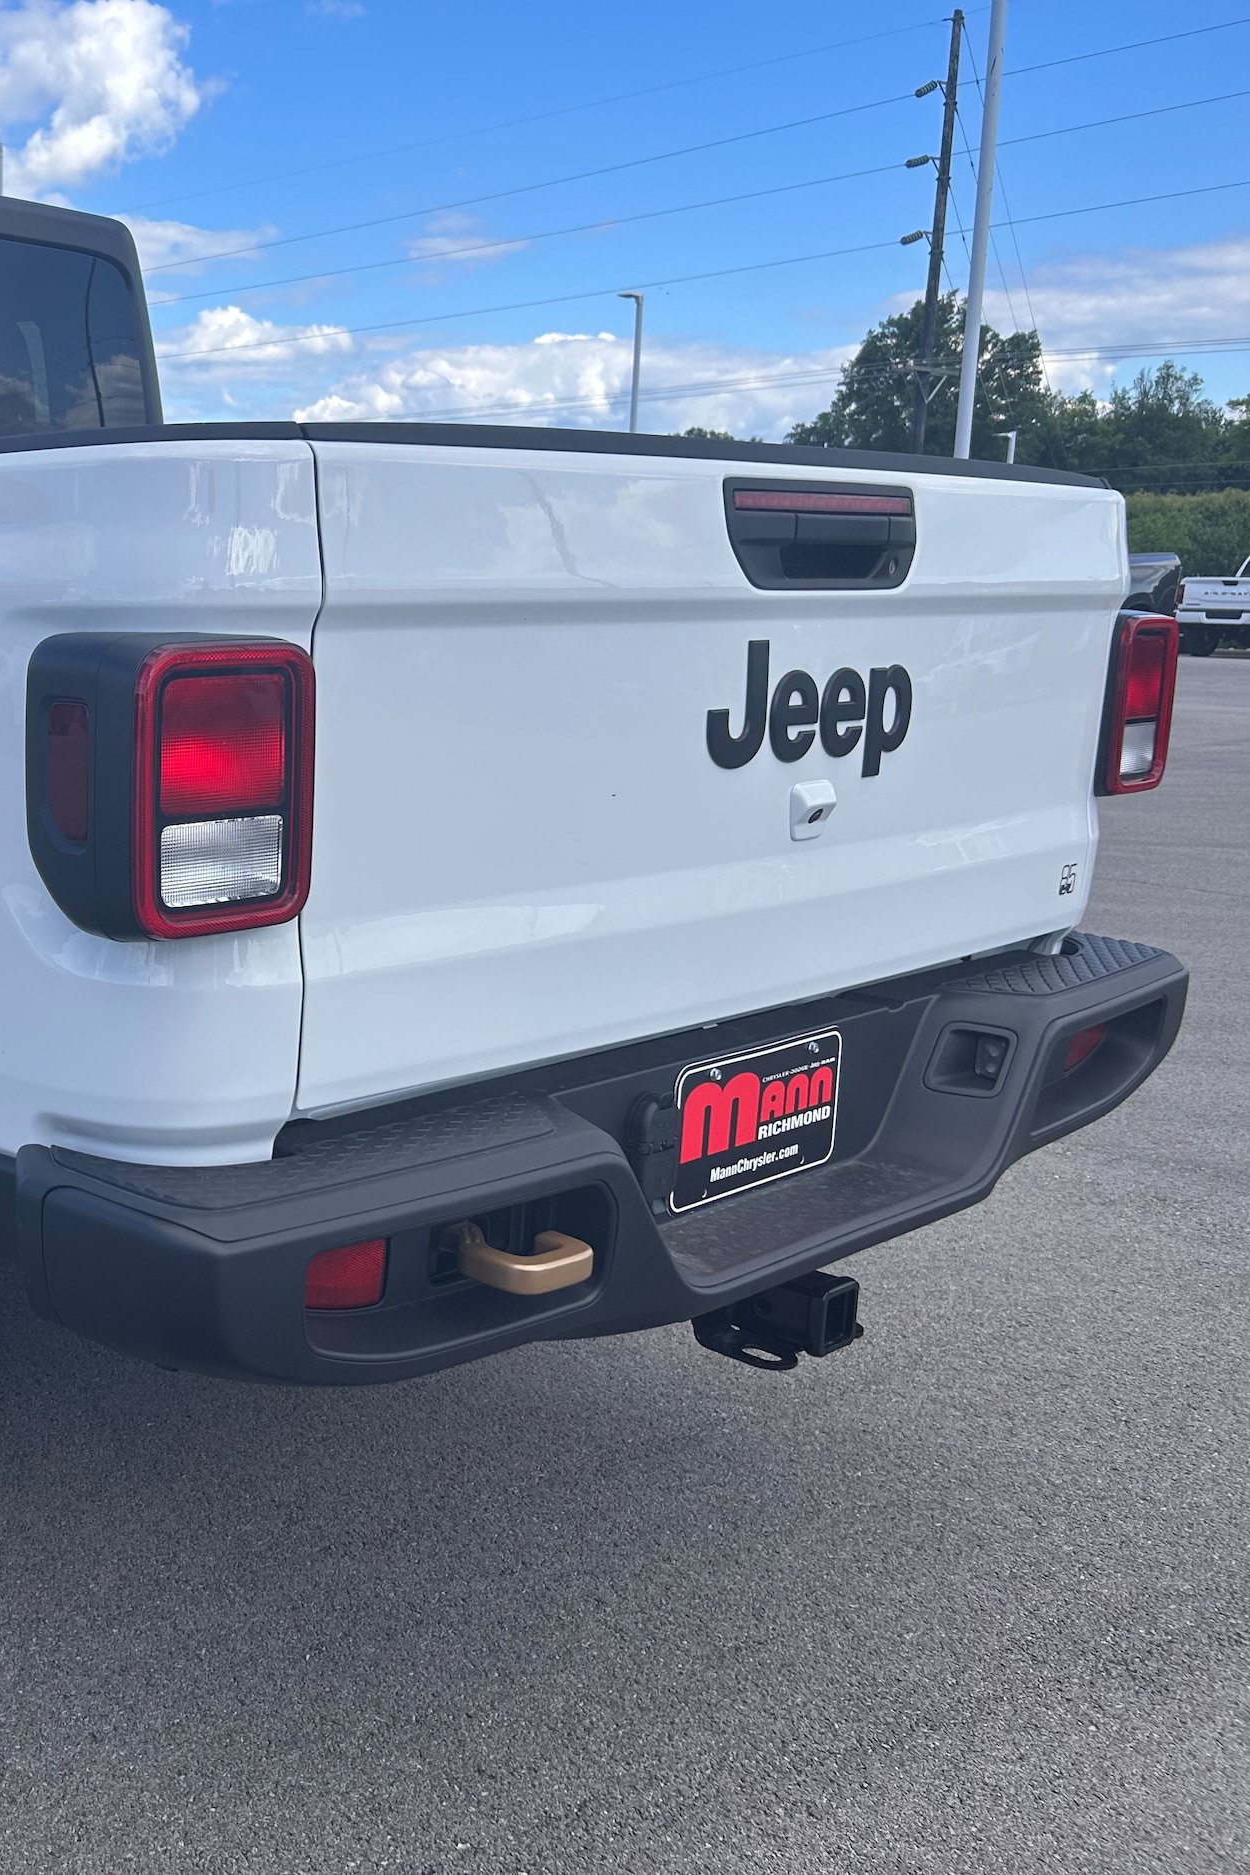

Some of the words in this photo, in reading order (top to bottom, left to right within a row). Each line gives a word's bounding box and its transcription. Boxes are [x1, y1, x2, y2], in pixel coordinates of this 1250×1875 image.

[706, 639, 913, 778] Jeep
[757, 1105, 831, 1141] RICHMOND
[709, 1143, 799, 1183] MannChrysler.com
